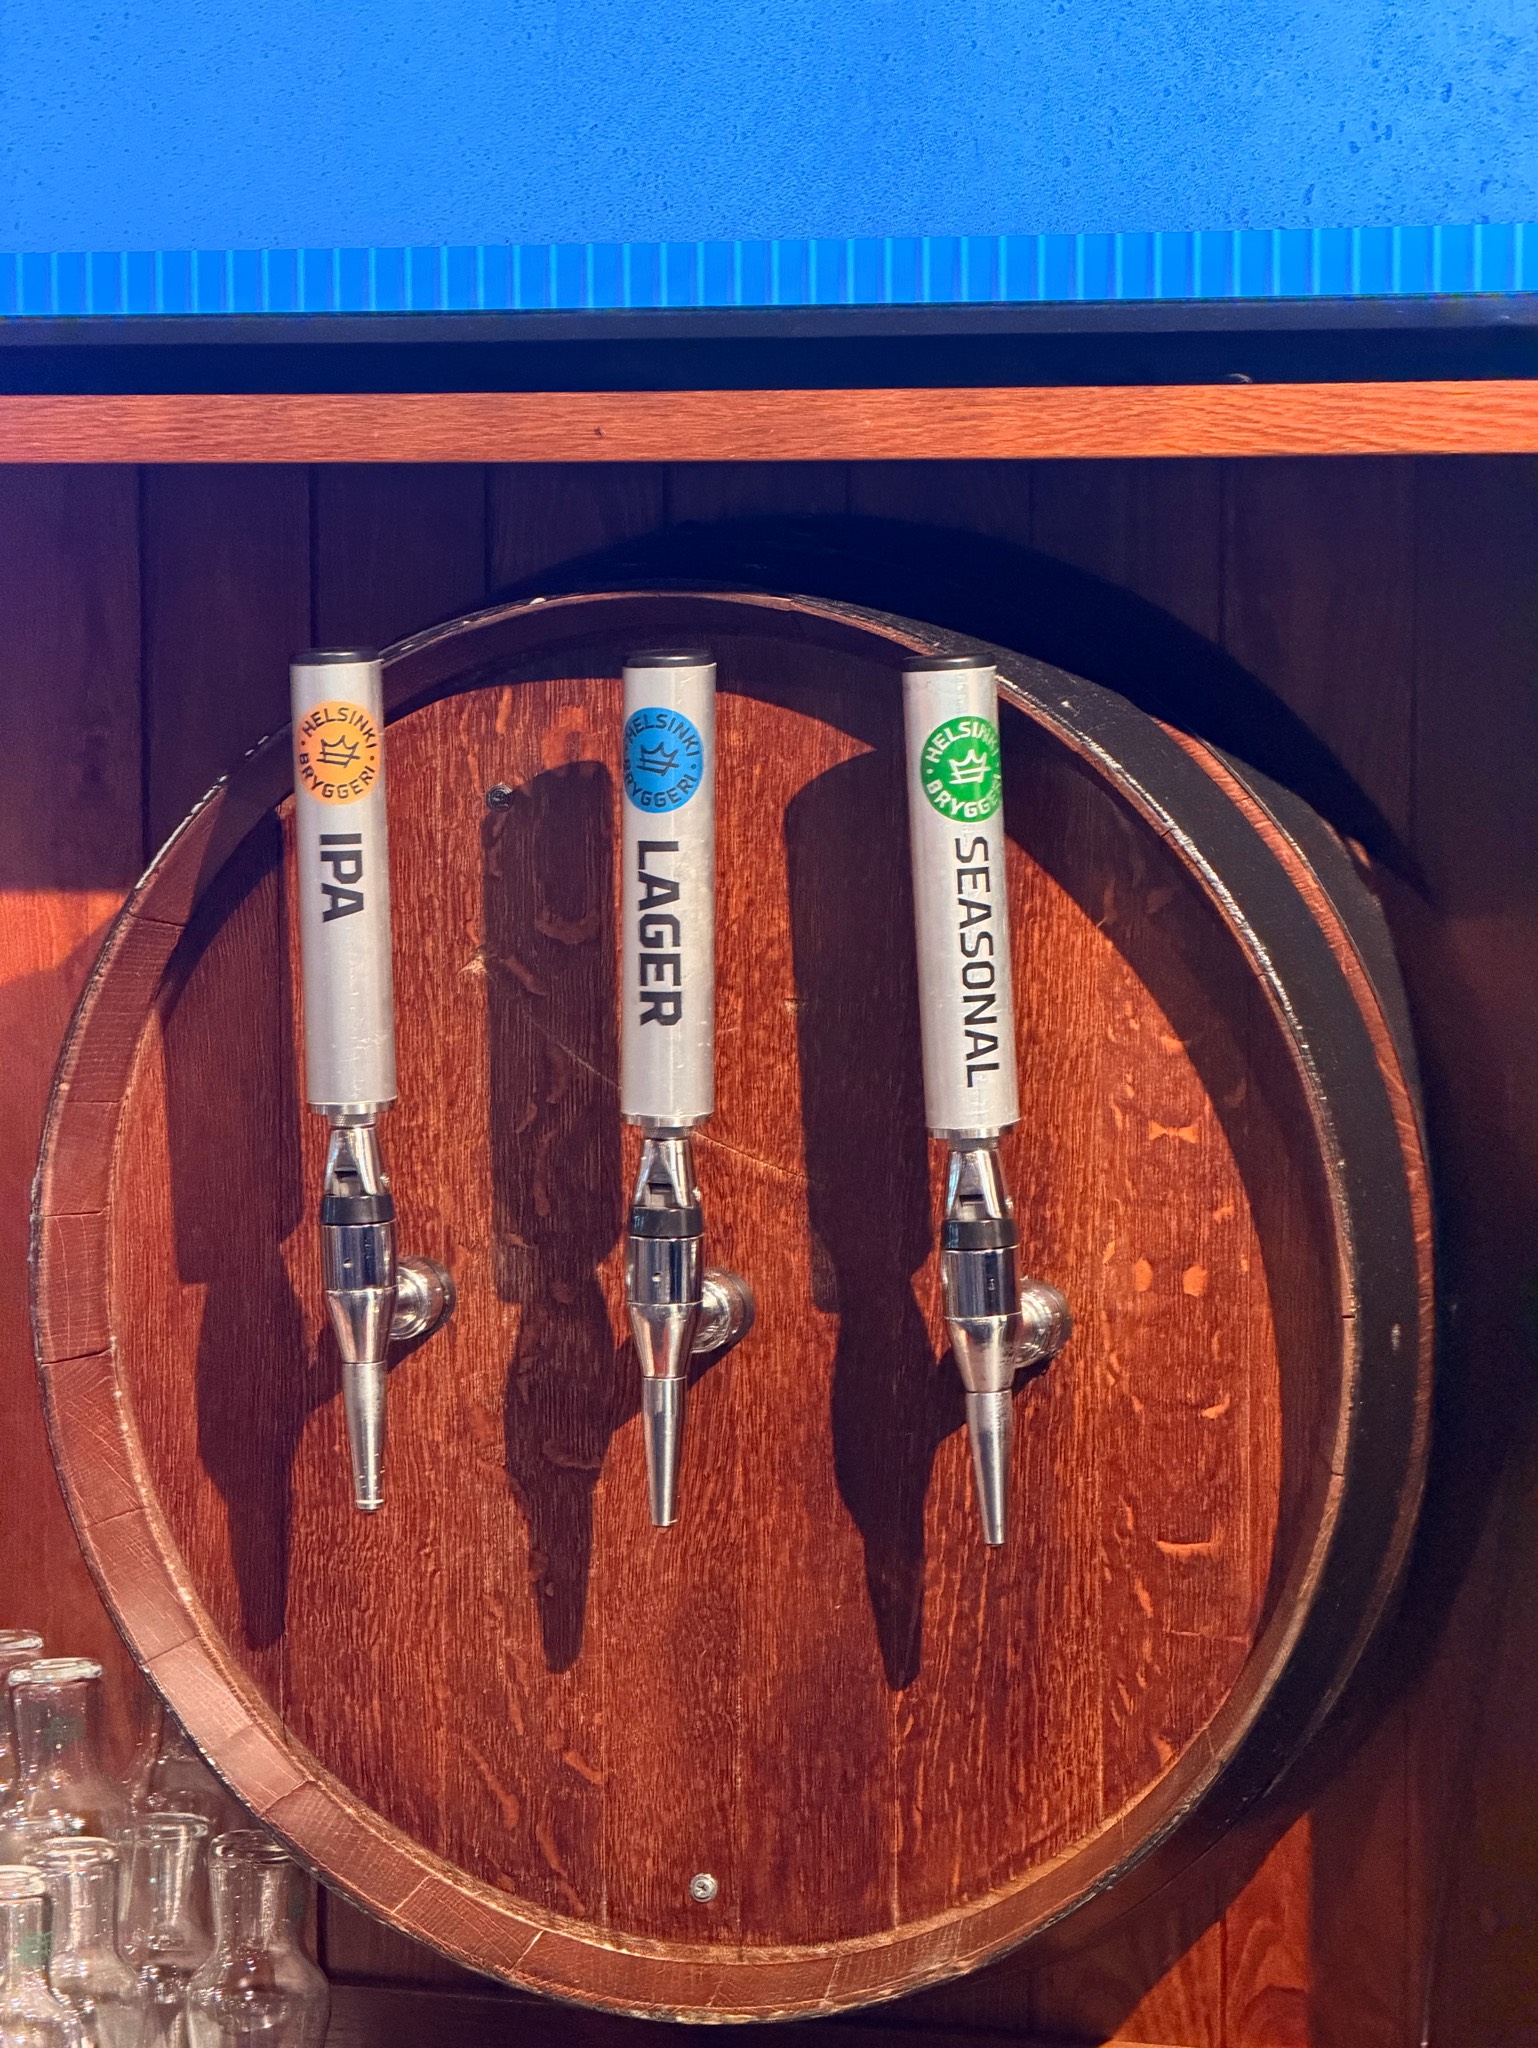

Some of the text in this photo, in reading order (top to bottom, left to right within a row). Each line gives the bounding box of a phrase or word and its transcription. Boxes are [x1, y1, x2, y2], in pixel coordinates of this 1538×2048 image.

[302, 707, 377, 749] HELSINKI
[624, 714, 700, 757] HELSINKI
[300, 753, 376, 799] BRYGGERI
[320, 833, 364, 923] IPA
[638, 841, 682, 1026] LAGER
[955, 836, 1000, 1088] SEASONAL
